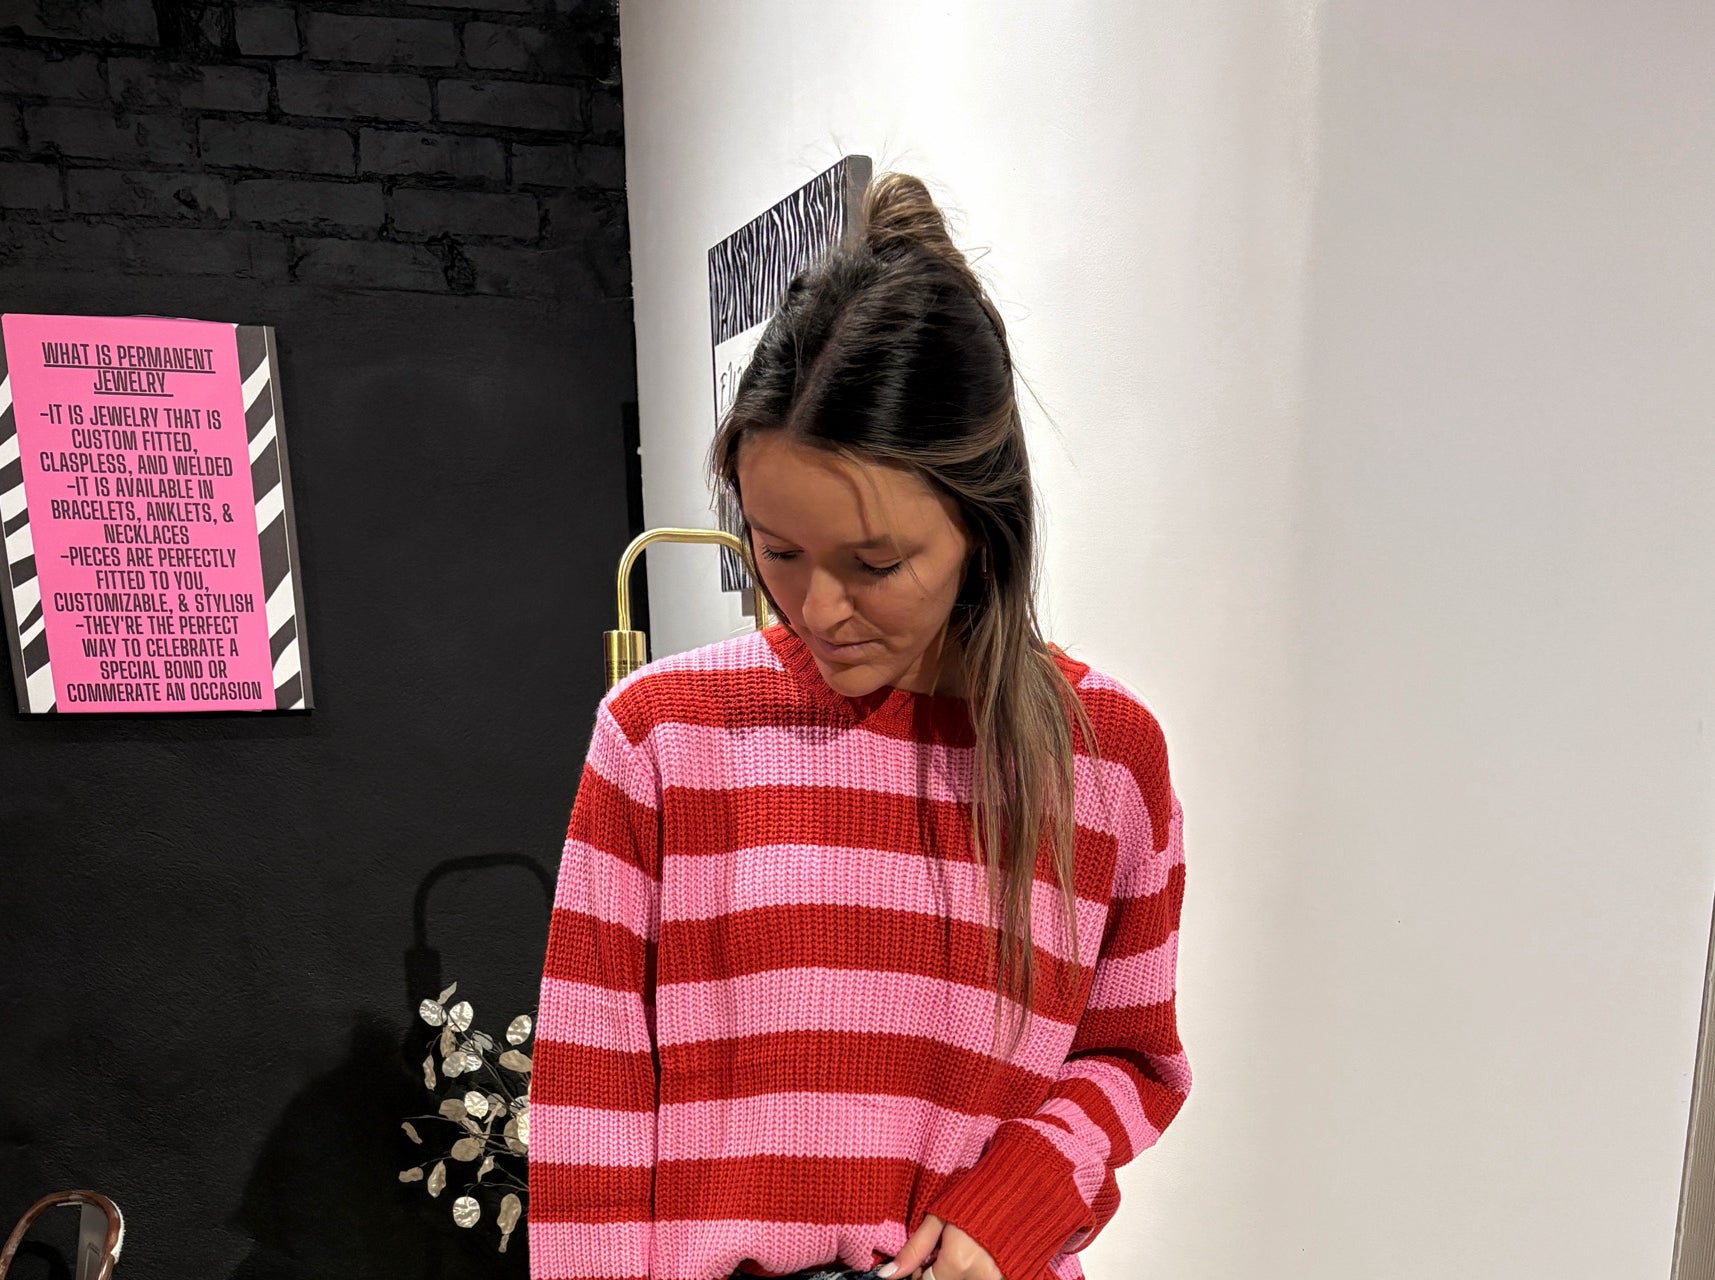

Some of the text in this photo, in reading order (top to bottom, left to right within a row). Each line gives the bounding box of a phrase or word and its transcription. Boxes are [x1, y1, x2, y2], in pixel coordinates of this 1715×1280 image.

[42, 342, 213, 371] WHAT IS PERMANENT
[94, 370, 166, 393] JEWELRY
[68, 405, 83, 425] IS
[90, 406, 158, 428] JEWELRY
[163, 408, 201, 429] THAT
[206, 410, 222, 430] IS
[71, 429, 198, 455] CUSTOM FITTED,
[40, 452, 233, 477] CLASPLESS, AND WELDED
[94, 477, 110, 497] IS
[116, 478, 192, 499] AVAILABLE
[198, 480, 214, 500] IN
[52, 500, 234, 525] BRACELETS, ANKLETS, &
[104, 524, 190, 544] NECKLACES
[126, 548, 155, 567] ARE
[158, 548, 236, 568] PERFECTLY
[96, 570, 210, 593] FITTED TO YOU,
[53, 592, 254, 615] CUSTOMIZABLE, & STYLISH
[149, 615, 174, 635] THE
[179, 615, 239, 635] PERFECT
[82, 638, 239, 658] WAY TO CELEBRATE A
[100, 660, 228, 680] SPECIAL BOND OR
[66, 681, 262, 702] COMMERATE AN OCCASION
